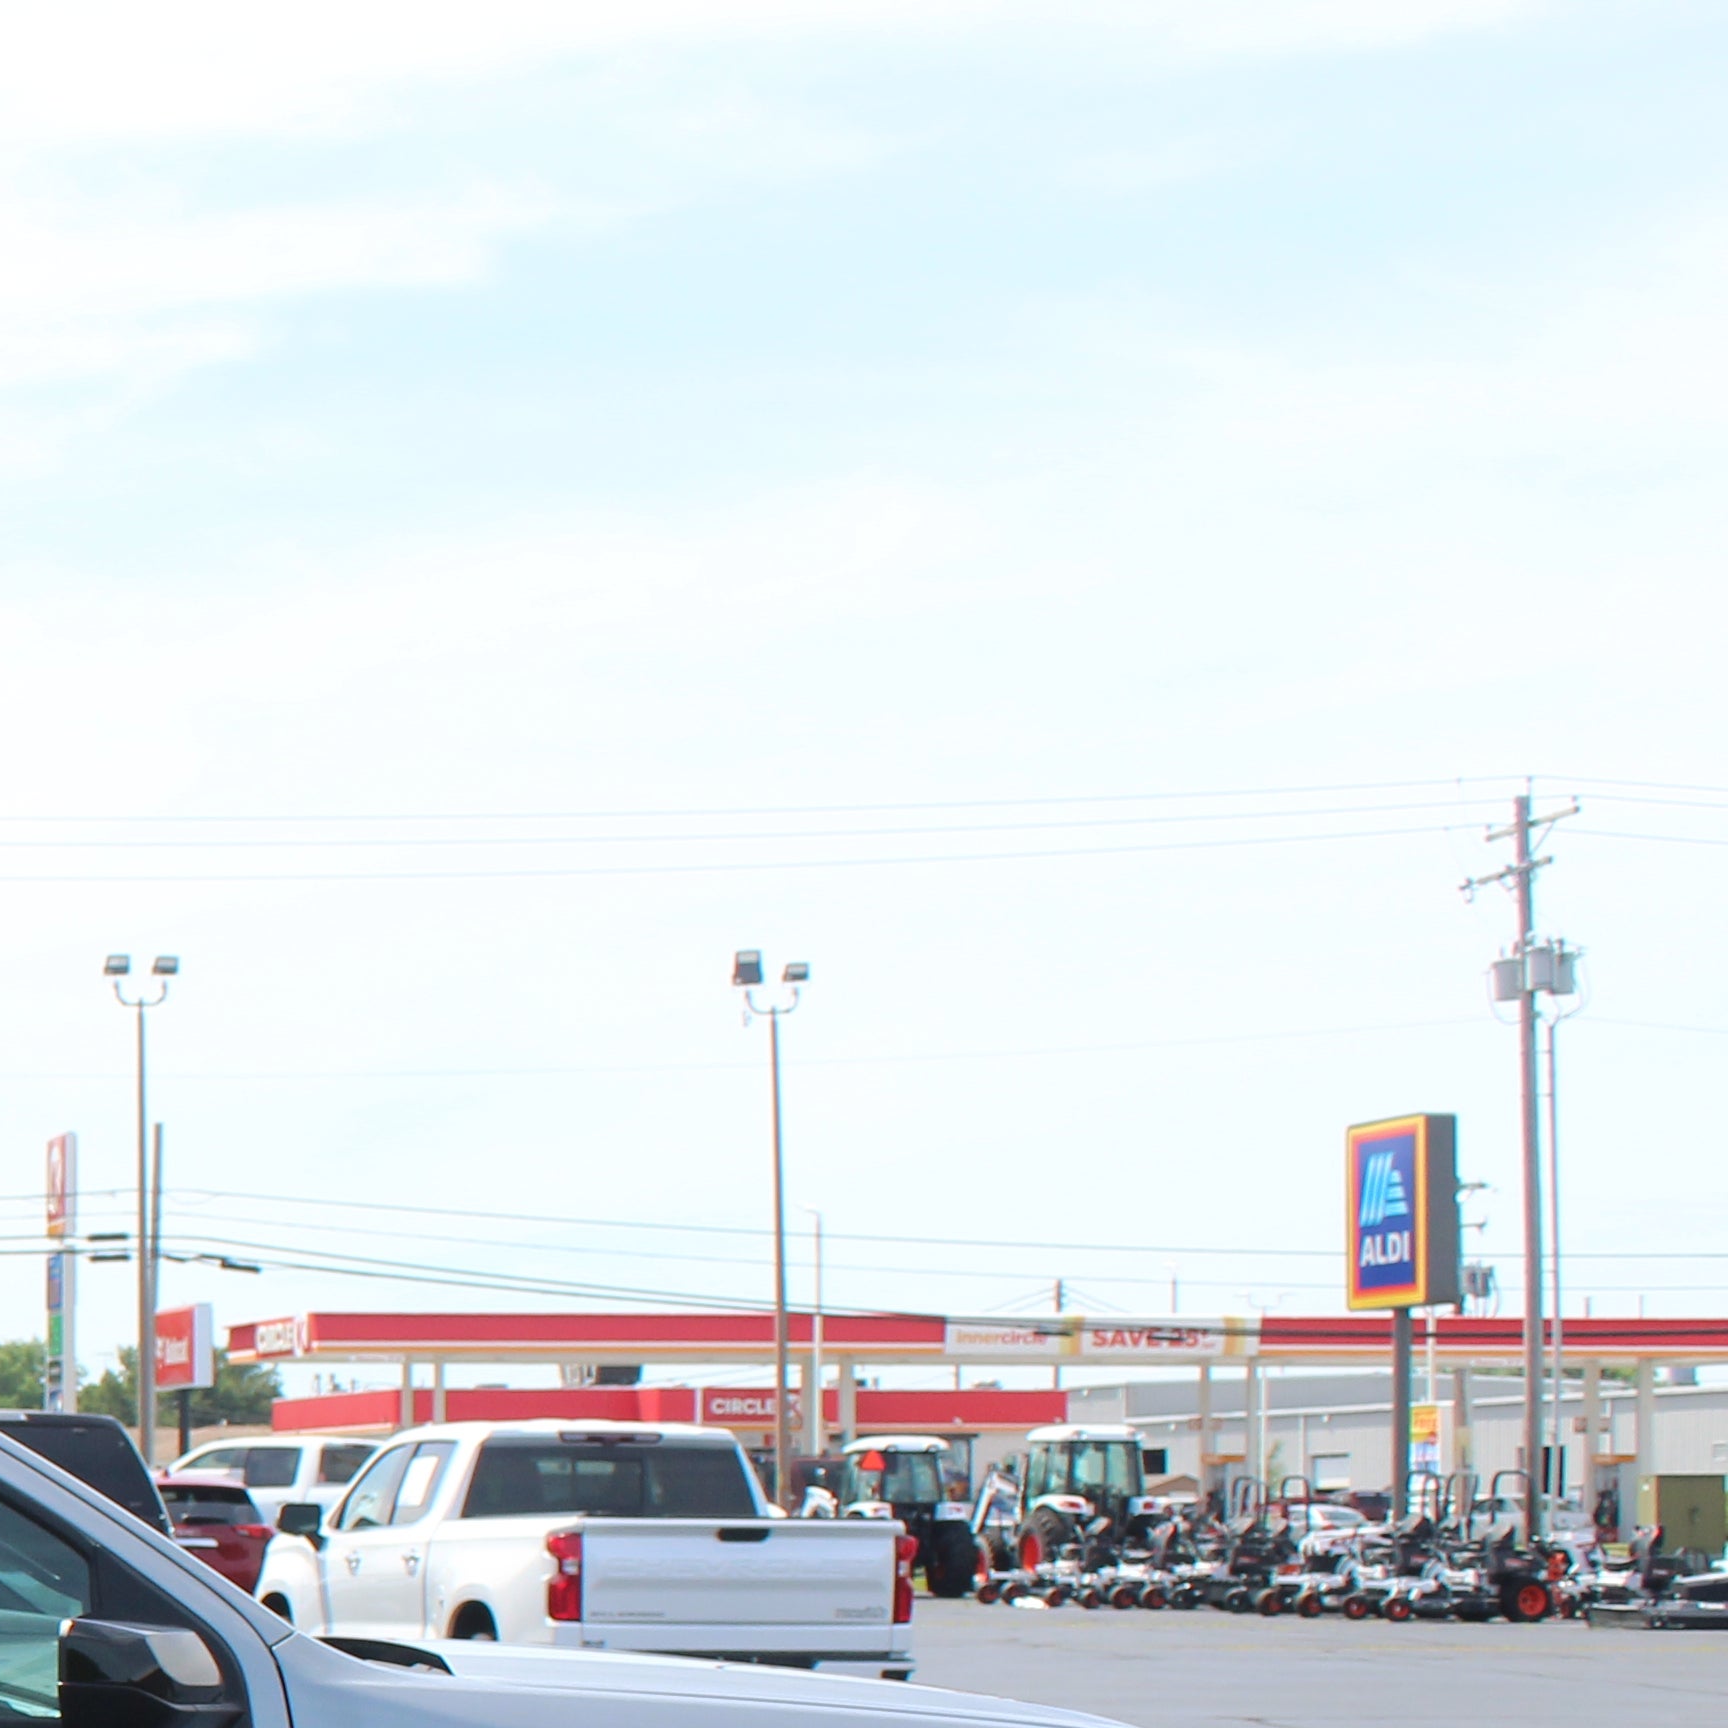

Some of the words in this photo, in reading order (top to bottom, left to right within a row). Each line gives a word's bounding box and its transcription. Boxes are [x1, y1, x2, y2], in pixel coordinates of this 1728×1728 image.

[1359, 1231, 1410, 1267] ALDI
[1092, 1327, 1159, 1348] SAVE
[710, 1398, 777, 1415] CIRCLE
